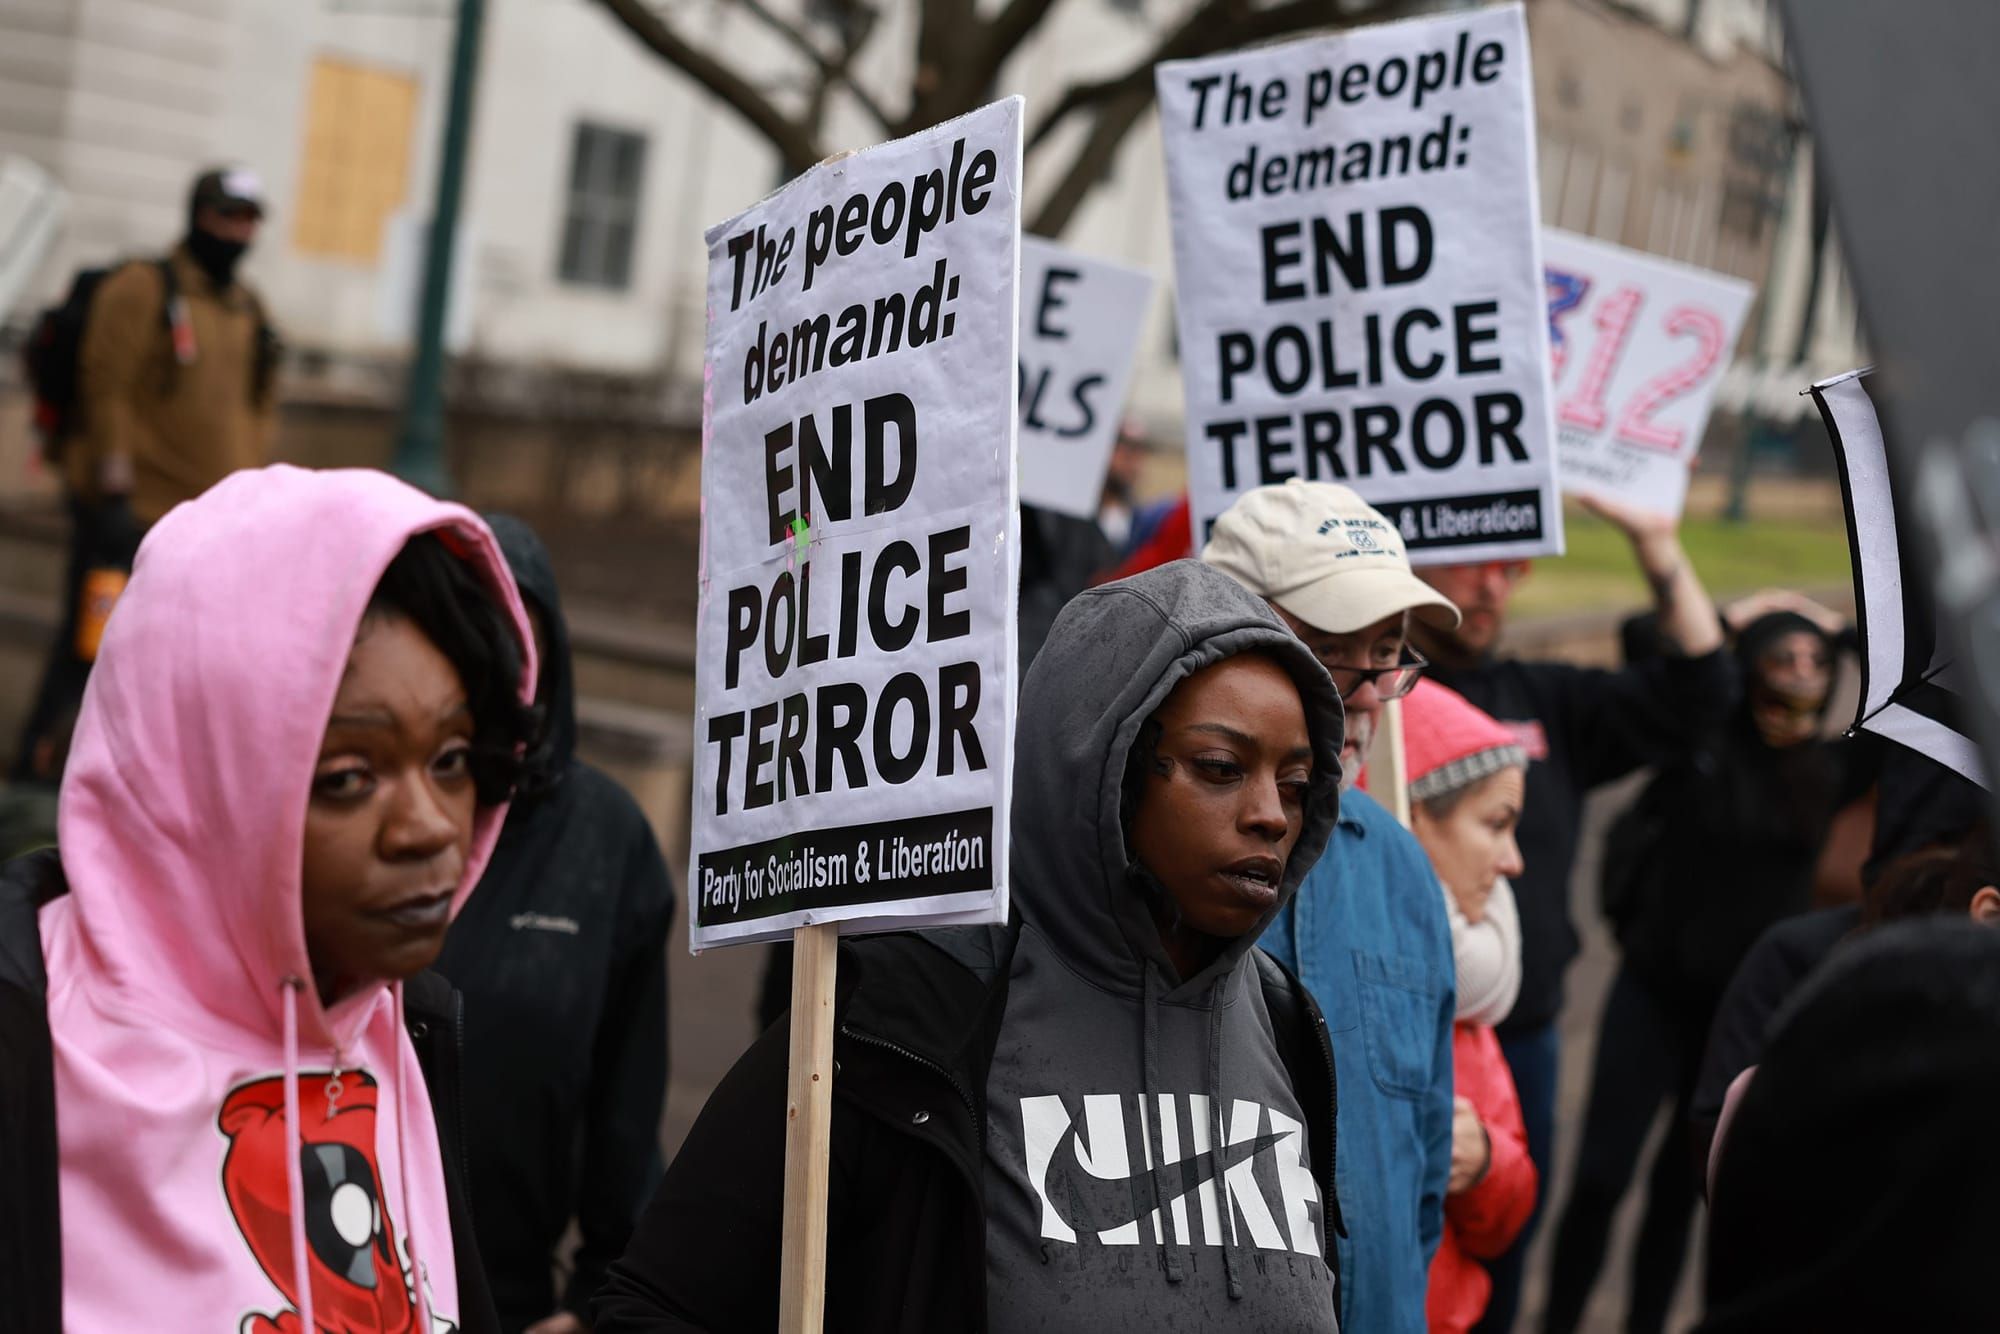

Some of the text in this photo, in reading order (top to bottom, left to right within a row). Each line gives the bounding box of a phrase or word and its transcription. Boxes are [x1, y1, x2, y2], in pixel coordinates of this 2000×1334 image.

[1188, 31, 1506, 132] The people
[1225, 113, 1474, 202] demand:
[728, 137, 997, 312] The people
[1260, 204, 1436, 302] END
[744, 258, 961, 405] demand:
[1217, 299, 1504, 402] POLICE
[1018, 359, 1106, 438] LS
[1205, 391, 1531, 492] TERROR
[764, 392, 917, 547] END
[1400, 498, 1537, 541] & Liberation
[725, 525, 970, 690] POLICE
[708, 661, 988, 816] TERROR
[703, 829, 985, 914] Party for Socialism & Liberation
[1020, 1093, 1321, 1258] NIKE
